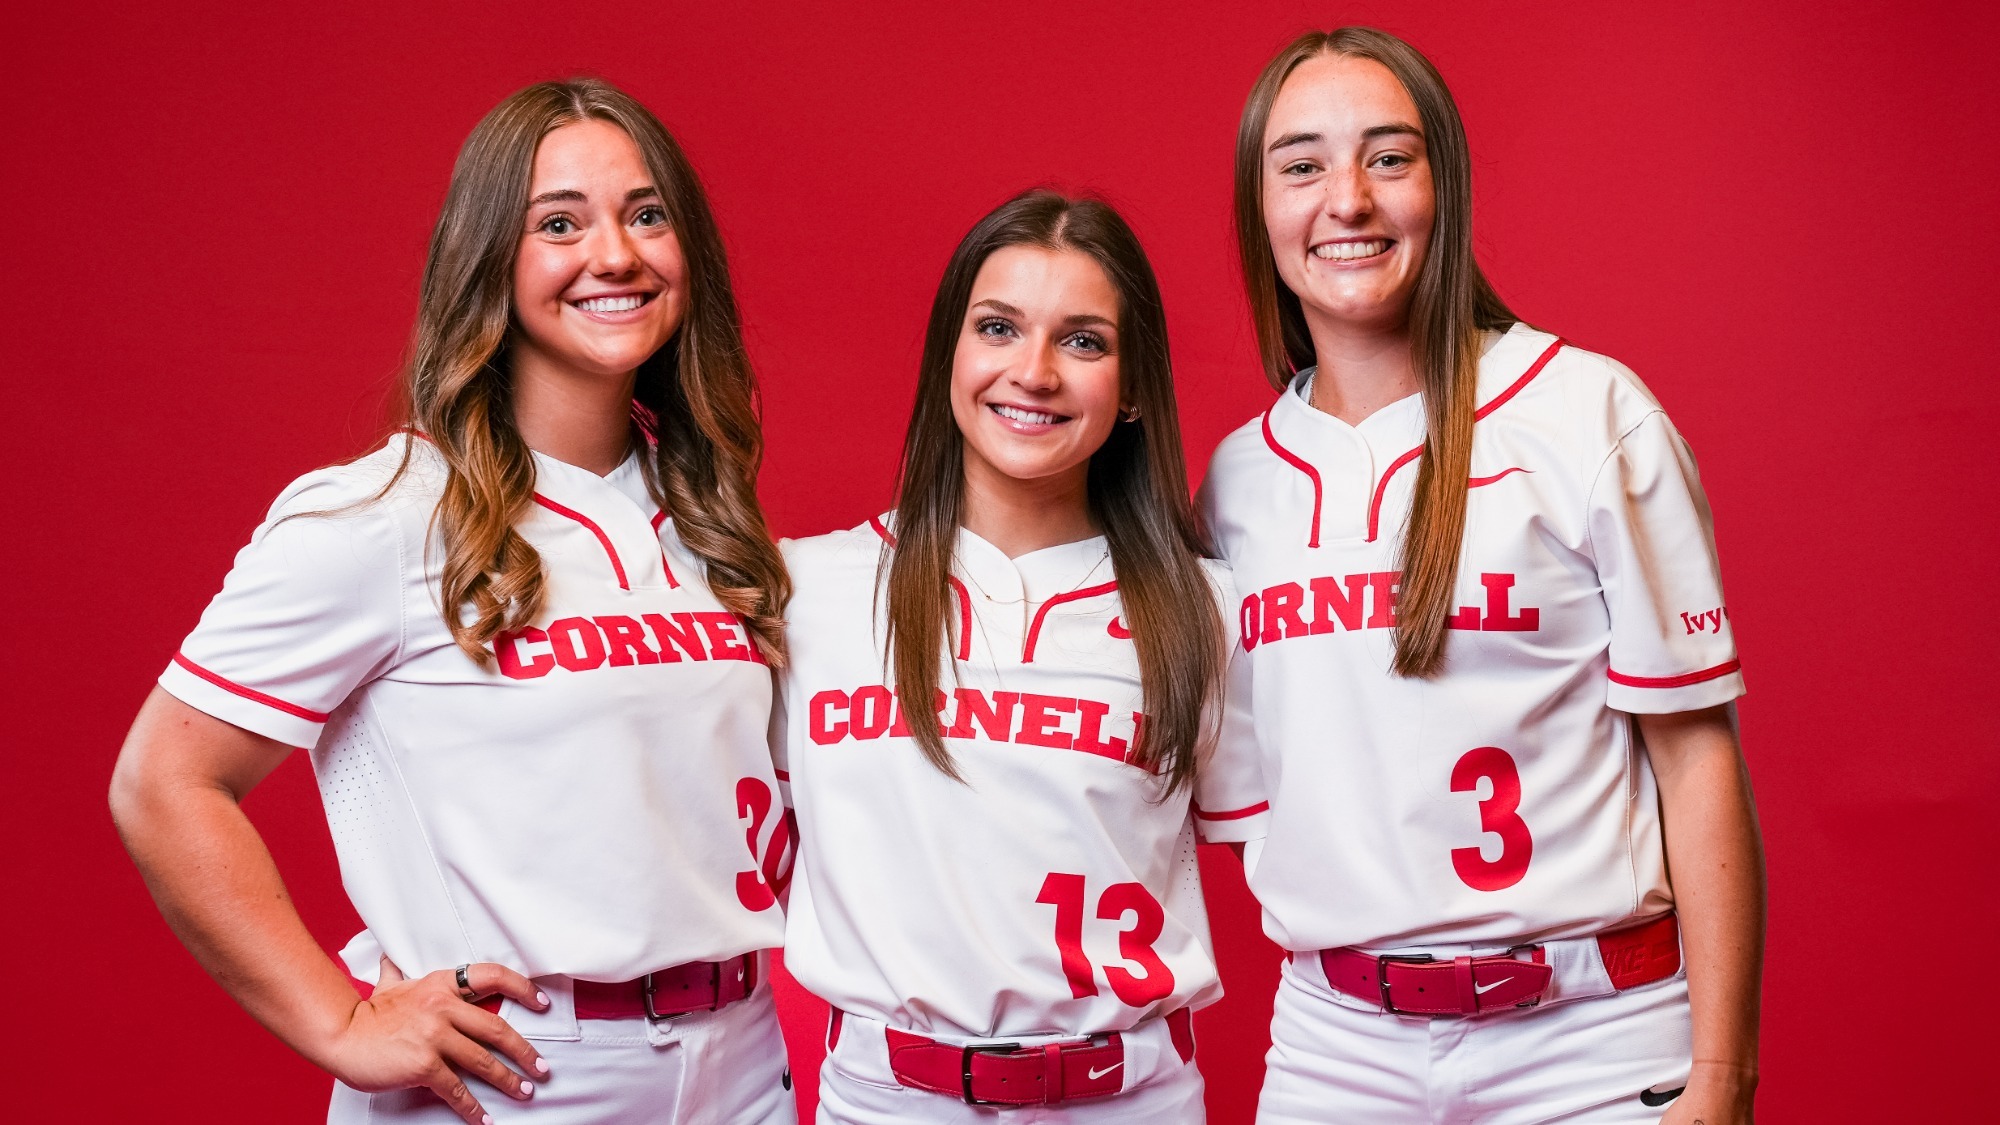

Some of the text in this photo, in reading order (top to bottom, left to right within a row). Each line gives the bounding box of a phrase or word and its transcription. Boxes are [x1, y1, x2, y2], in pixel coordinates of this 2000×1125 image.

[1240, 571, 1540, 653] ORNEL
[1680, 607, 1721, 635] Ivy
[1450, 747, 1533, 892] 3
[1035, 872, 1175, 1008] 13
